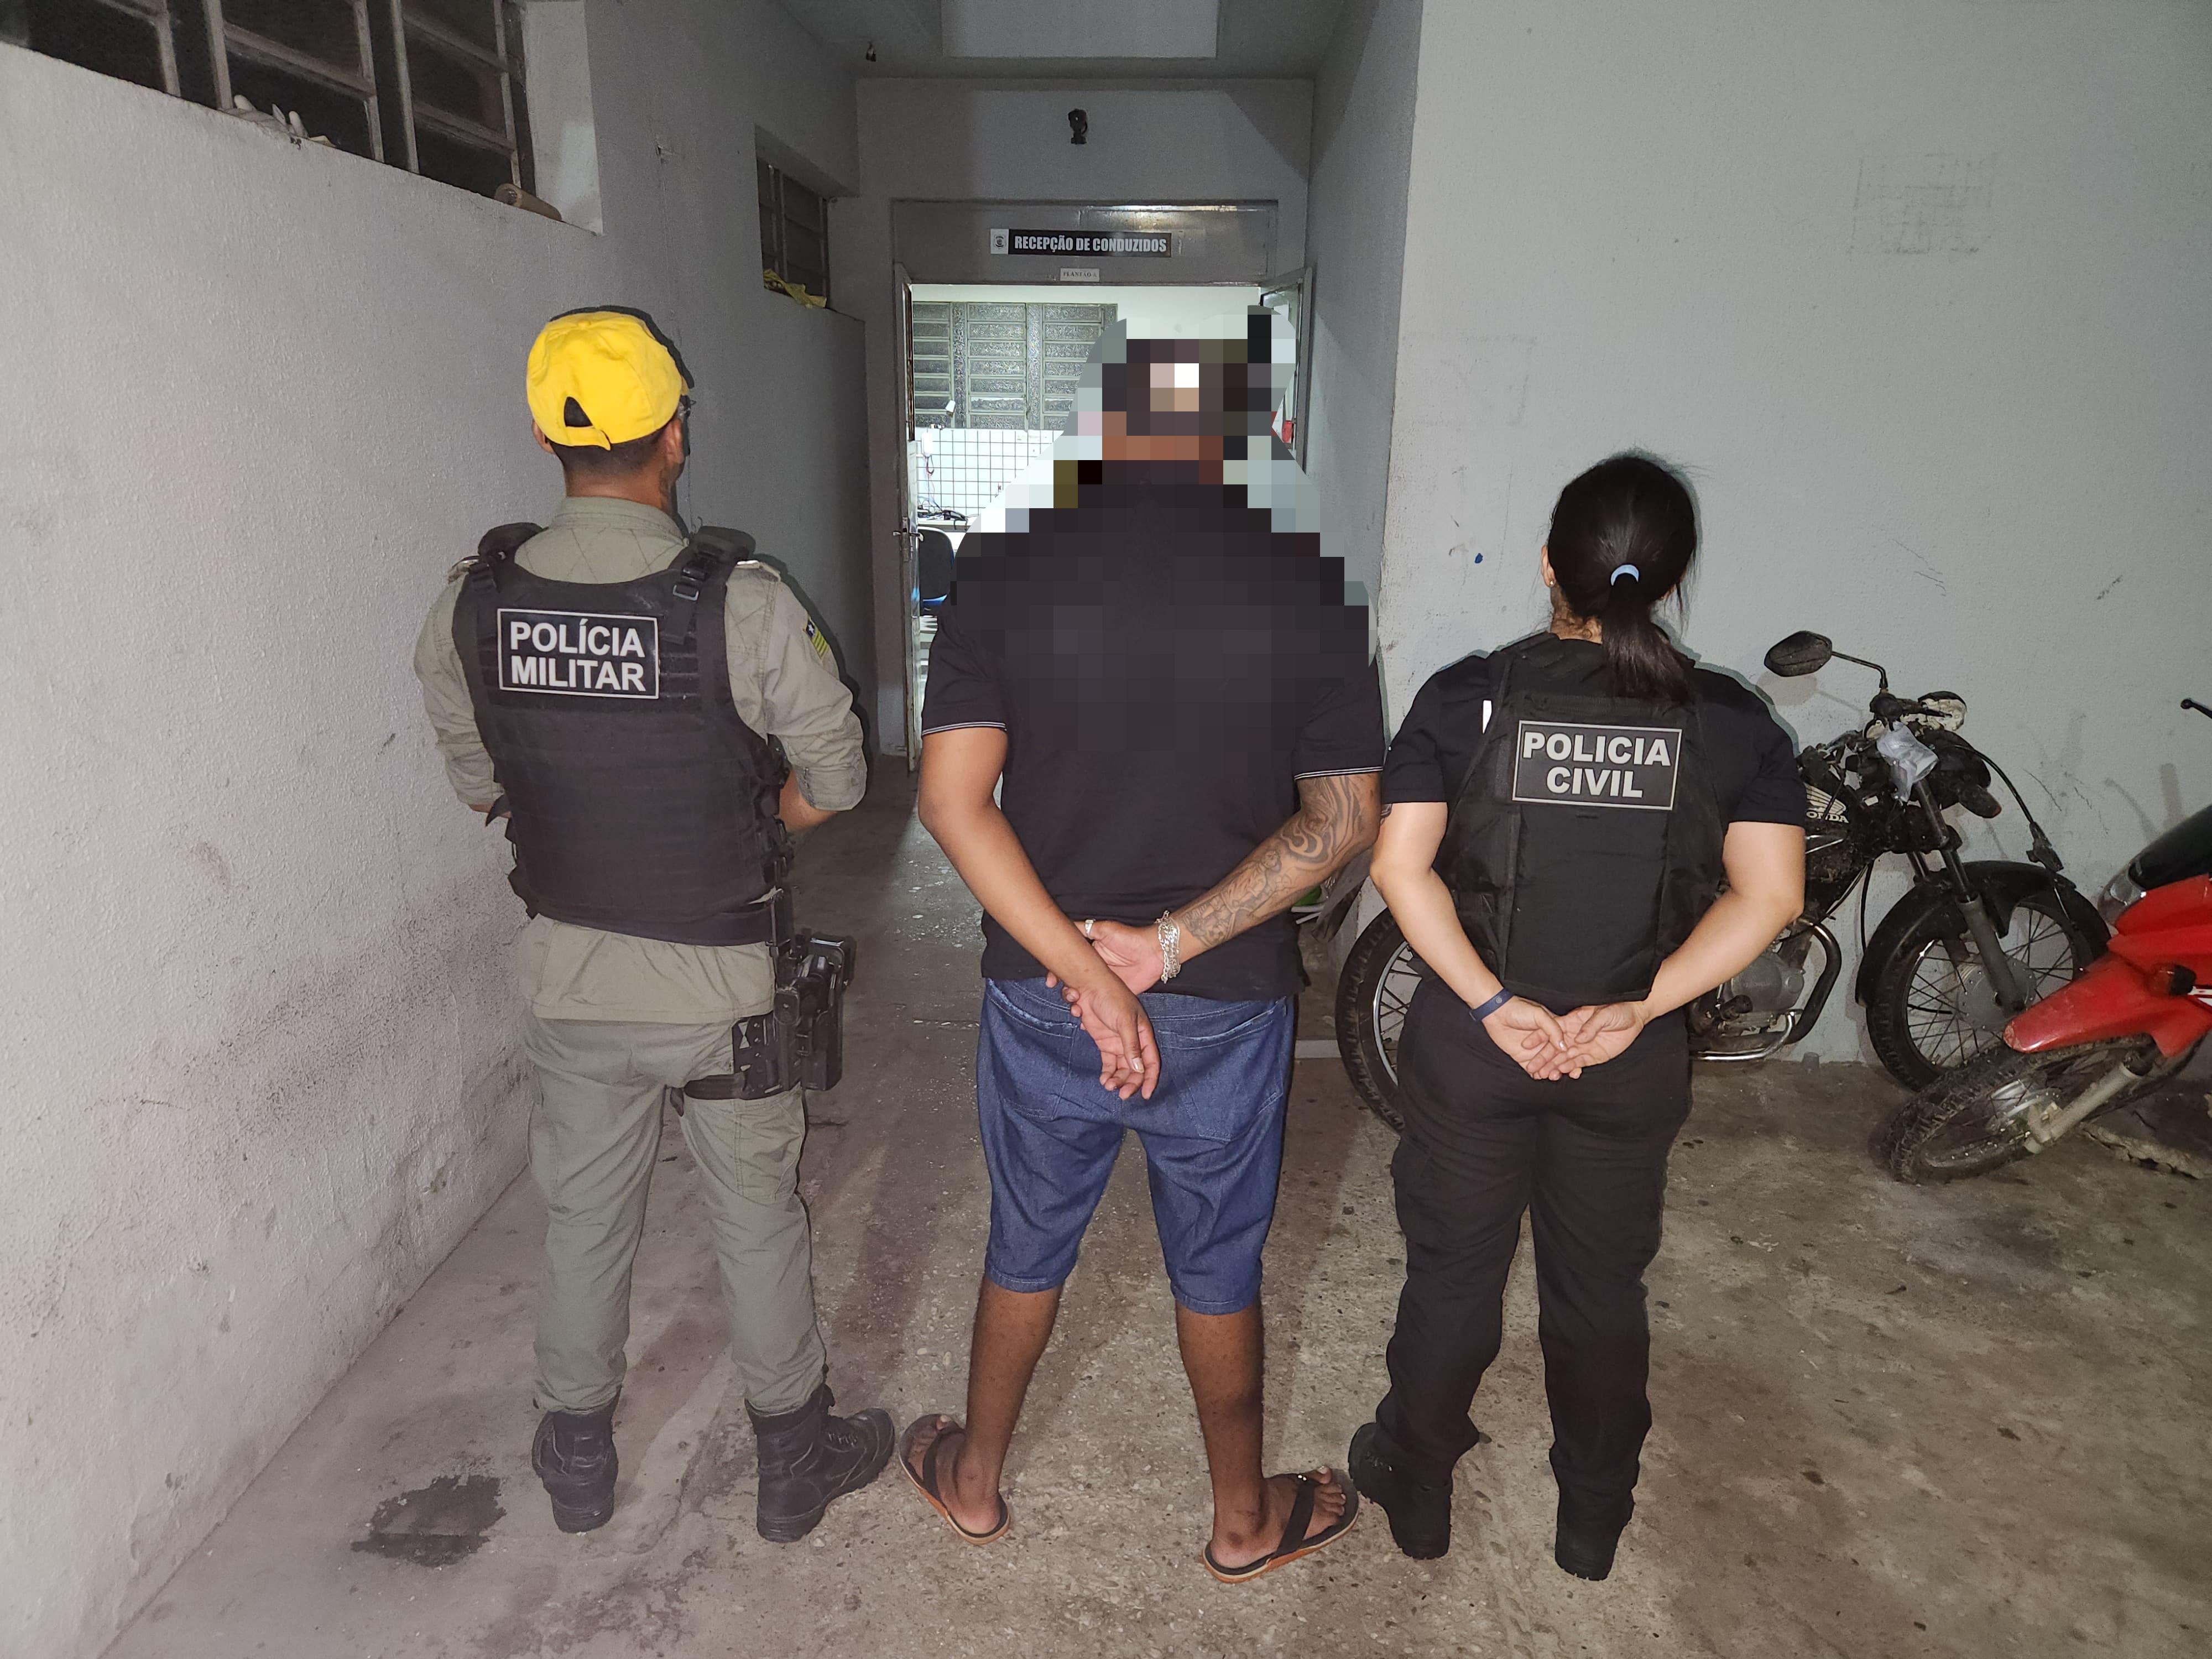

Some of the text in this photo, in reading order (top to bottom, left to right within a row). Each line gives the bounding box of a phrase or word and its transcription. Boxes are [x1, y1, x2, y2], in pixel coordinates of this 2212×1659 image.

[1014, 235, 1166, 253] RECEPÇÃO DE CONDUZIDOS
[510, 618, 645, 658] POLÍCIA
[512, 655, 646, 691] MILITAR
[1523, 732, 1671, 766] POLICIA
[1547, 766, 1643, 798] CIVIL
[1806, 811, 1849, 823] ONDA
